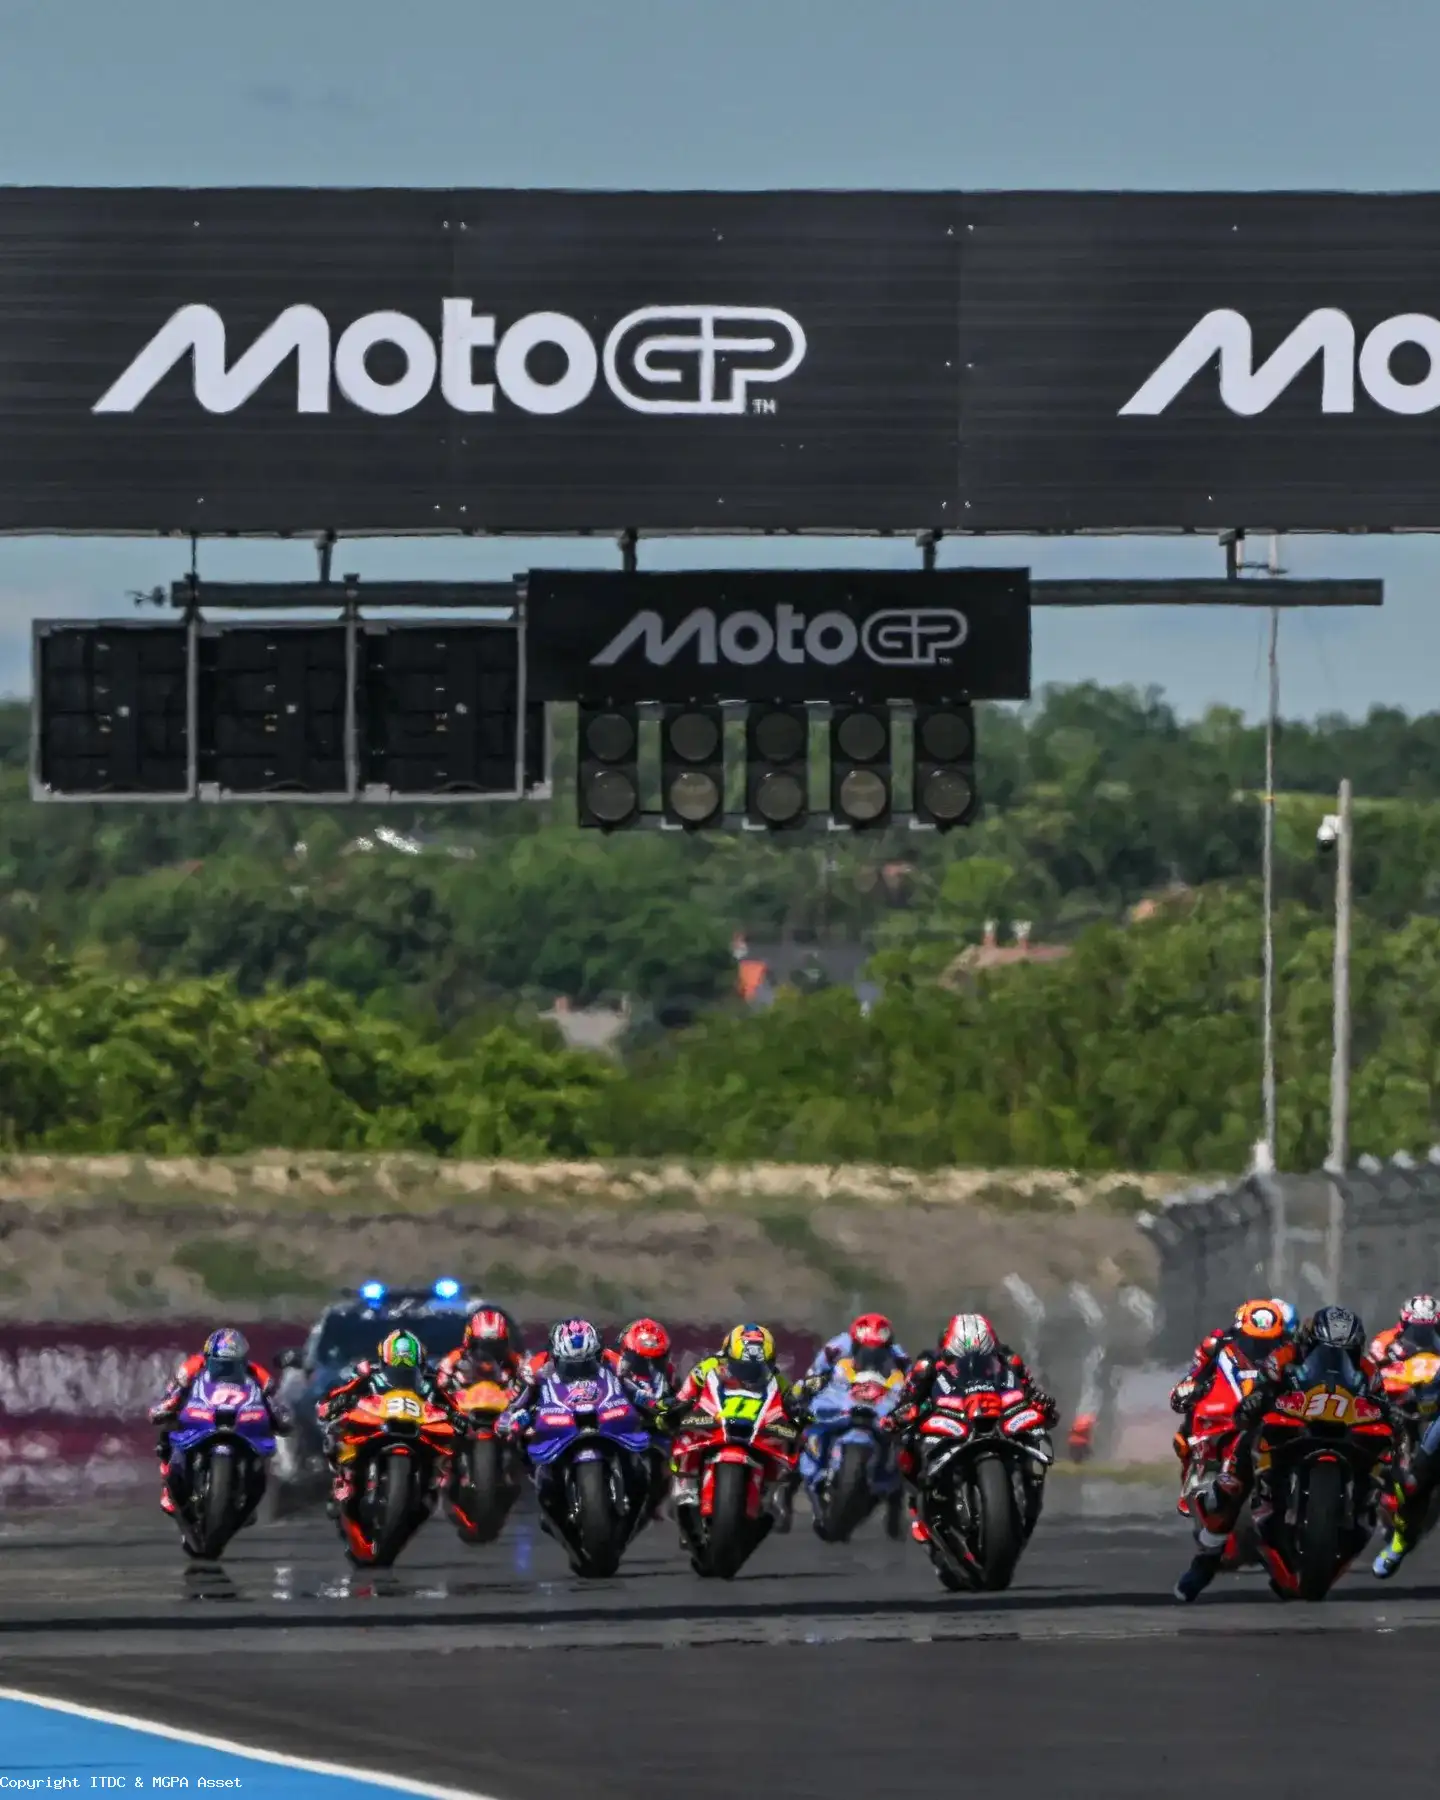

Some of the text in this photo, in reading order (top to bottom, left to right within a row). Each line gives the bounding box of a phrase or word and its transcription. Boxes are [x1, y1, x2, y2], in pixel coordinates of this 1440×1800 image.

[93, 298, 807, 414] MotoGP
[591, 604, 968, 665] MotoGP
[386, 1397, 420, 1418] 33
[1304, 1392, 1349, 1418] 37
